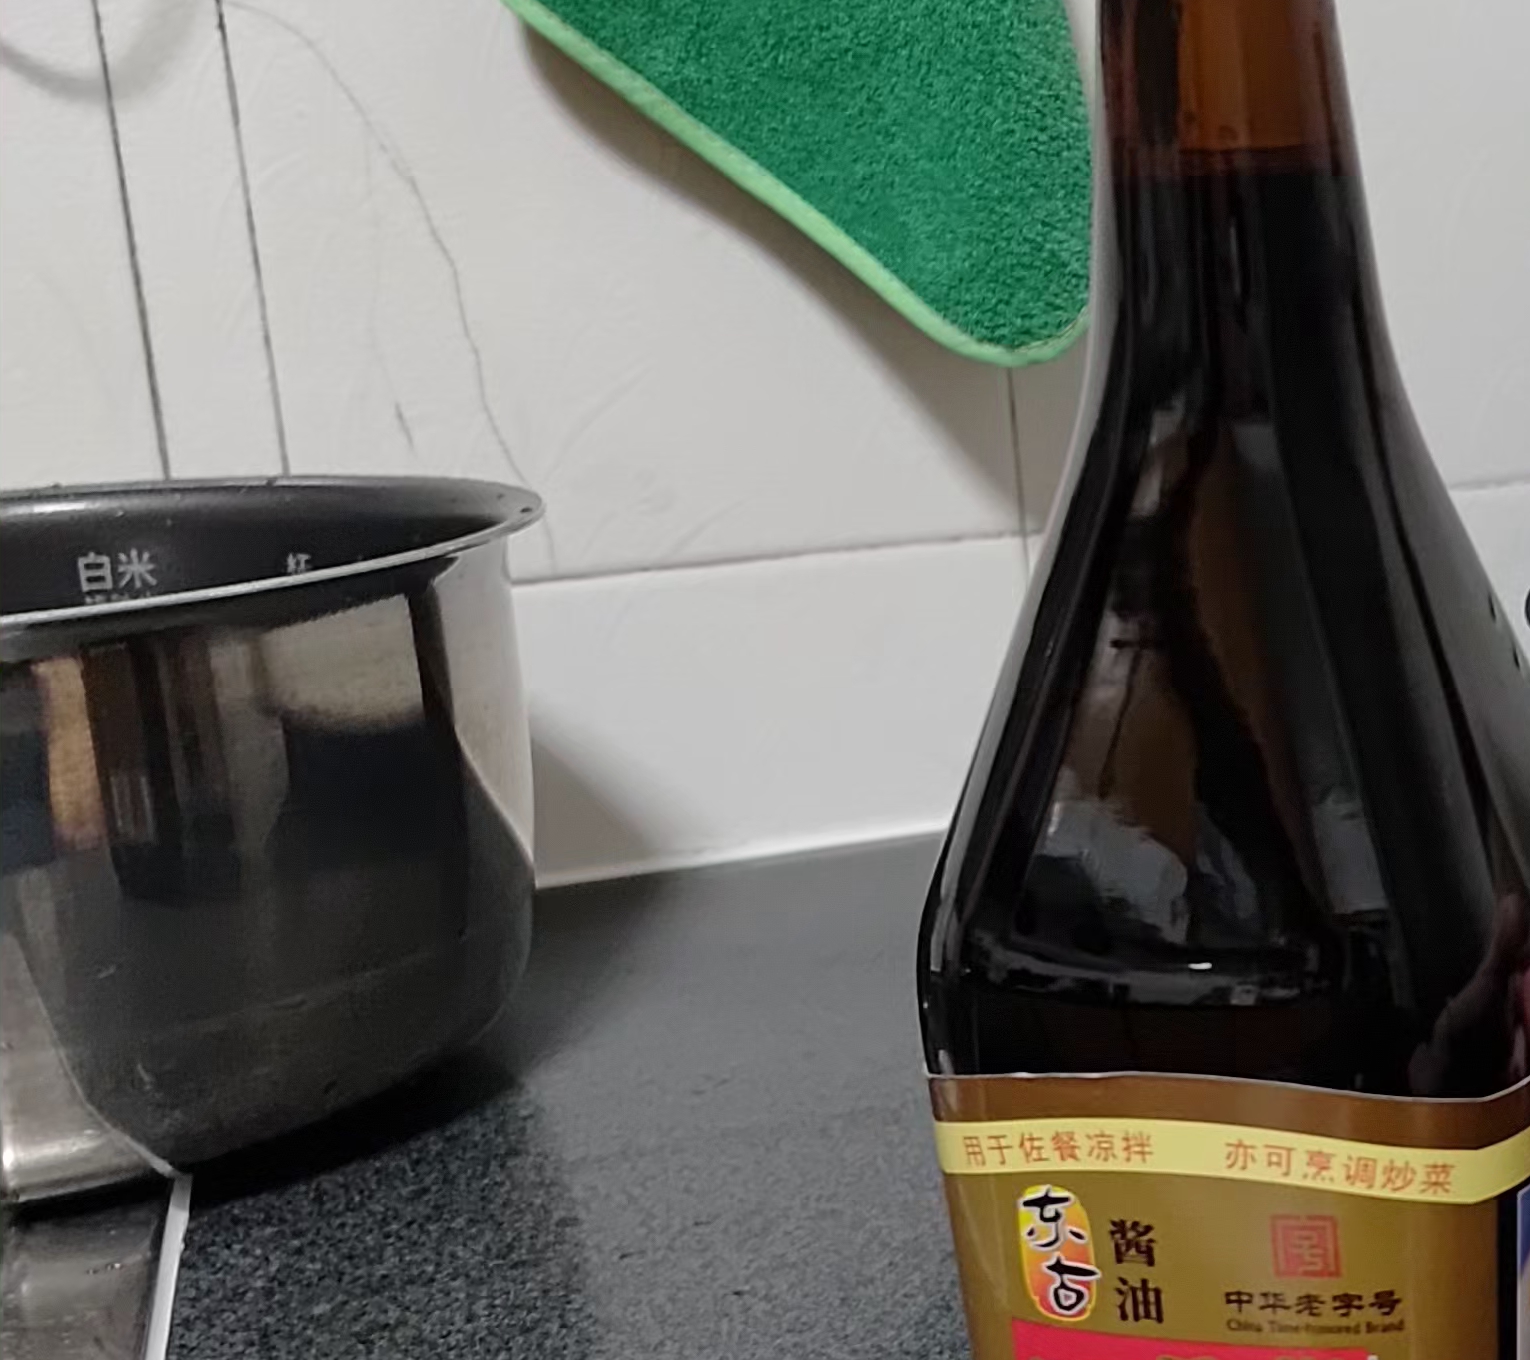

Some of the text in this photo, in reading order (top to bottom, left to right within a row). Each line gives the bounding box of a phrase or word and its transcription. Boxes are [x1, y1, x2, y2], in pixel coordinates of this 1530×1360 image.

[77, 548, 158, 593] 白米
[963, 1129, 1456, 1195] 用于佐餐凉拌 亦可烹调炒菜
[1017, 1184, 1103, 1316] 东古
[1108, 1218, 1164, 1324] 酱油
[1224, 1290, 1403, 1317] 中华老字号
